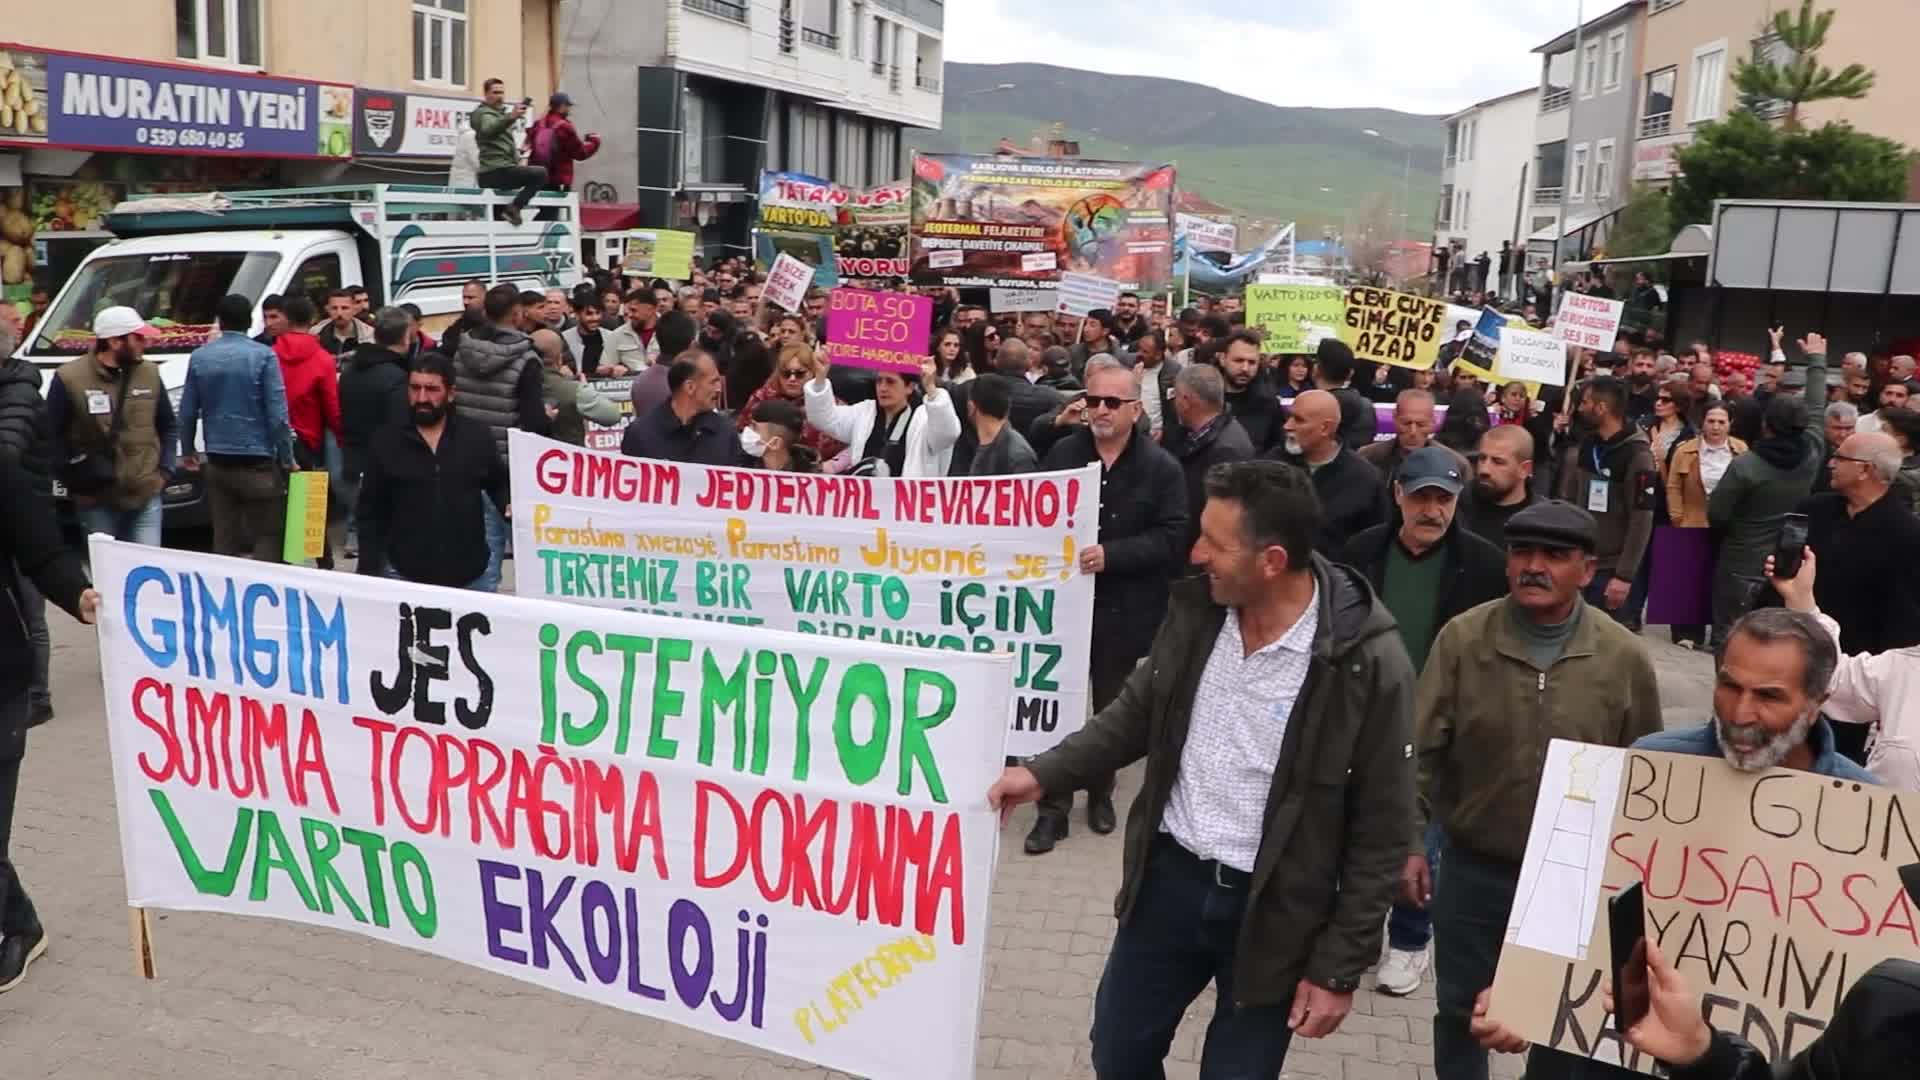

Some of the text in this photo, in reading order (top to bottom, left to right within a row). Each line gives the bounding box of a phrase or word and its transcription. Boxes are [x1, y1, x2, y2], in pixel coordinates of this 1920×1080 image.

[62, 72, 306, 131] MURATIN YERİ
[416, 107, 450, 129] APAK
[136, 127, 245, 149] 0 539 680 40 56
[924, 222, 981, 236] JEOTERMAL
[831, 289, 915, 320] BOTA SO
[1253, 288, 1297, 300] VARTO
[846, 317, 909, 343] JESO
[1356, 331, 1415, 362] AZAD
[535, 448, 681, 506] GIMGIM
[533, 503, 625, 547] Parastina
[725, 517, 840, 564] Parastina
[537, 549, 1056, 635] TERTEMİZ BİR VARTO İÇİN
[122, 564, 351, 706] GIMGIM
[369, 601, 494, 730] JES
[537, 622, 958, 804] İSTEMİYOR
[131, 676, 965, 946] SUYUMA TOPRAĞIMA DOKUNMA
[1622, 753, 1706, 826] BU
[147, 788, 769, 1030] VARTO EKOLOJİ
[792, 932, 937, 1048] PLATFORMU
